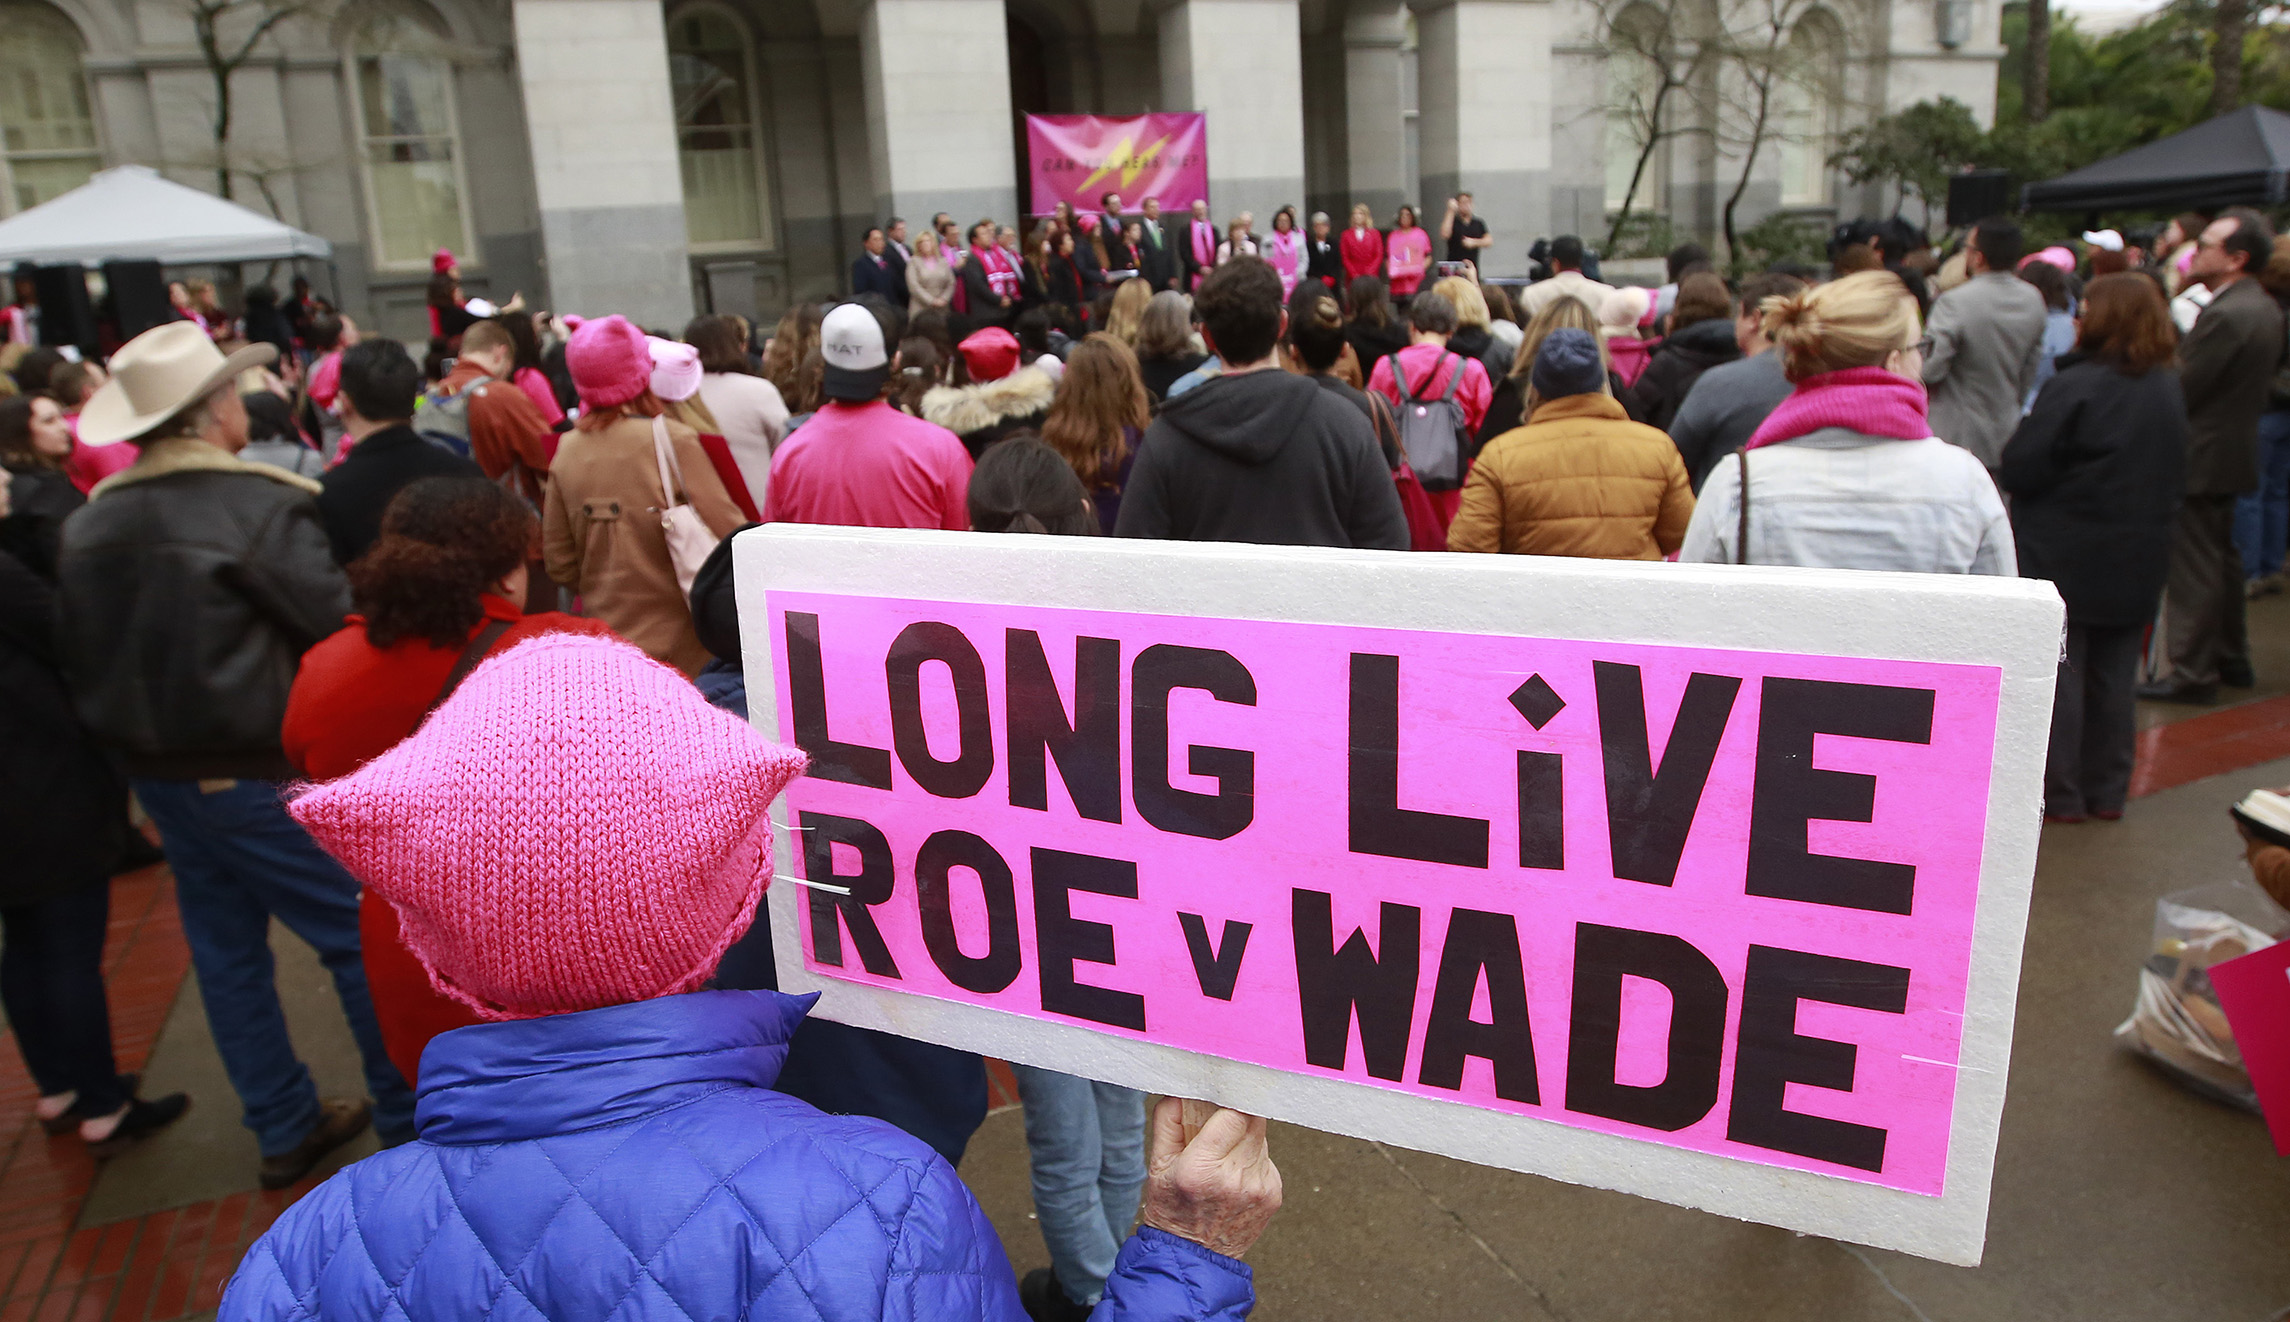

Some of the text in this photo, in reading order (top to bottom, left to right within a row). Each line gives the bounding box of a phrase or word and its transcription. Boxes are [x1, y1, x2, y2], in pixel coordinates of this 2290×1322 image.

[1042, 158, 1075, 172] CAN
[1122, 155, 1159, 169] HEAR
[785, 611, 1257, 841] LONG
[799, 810, 1911, 1174] ROE v WADE
